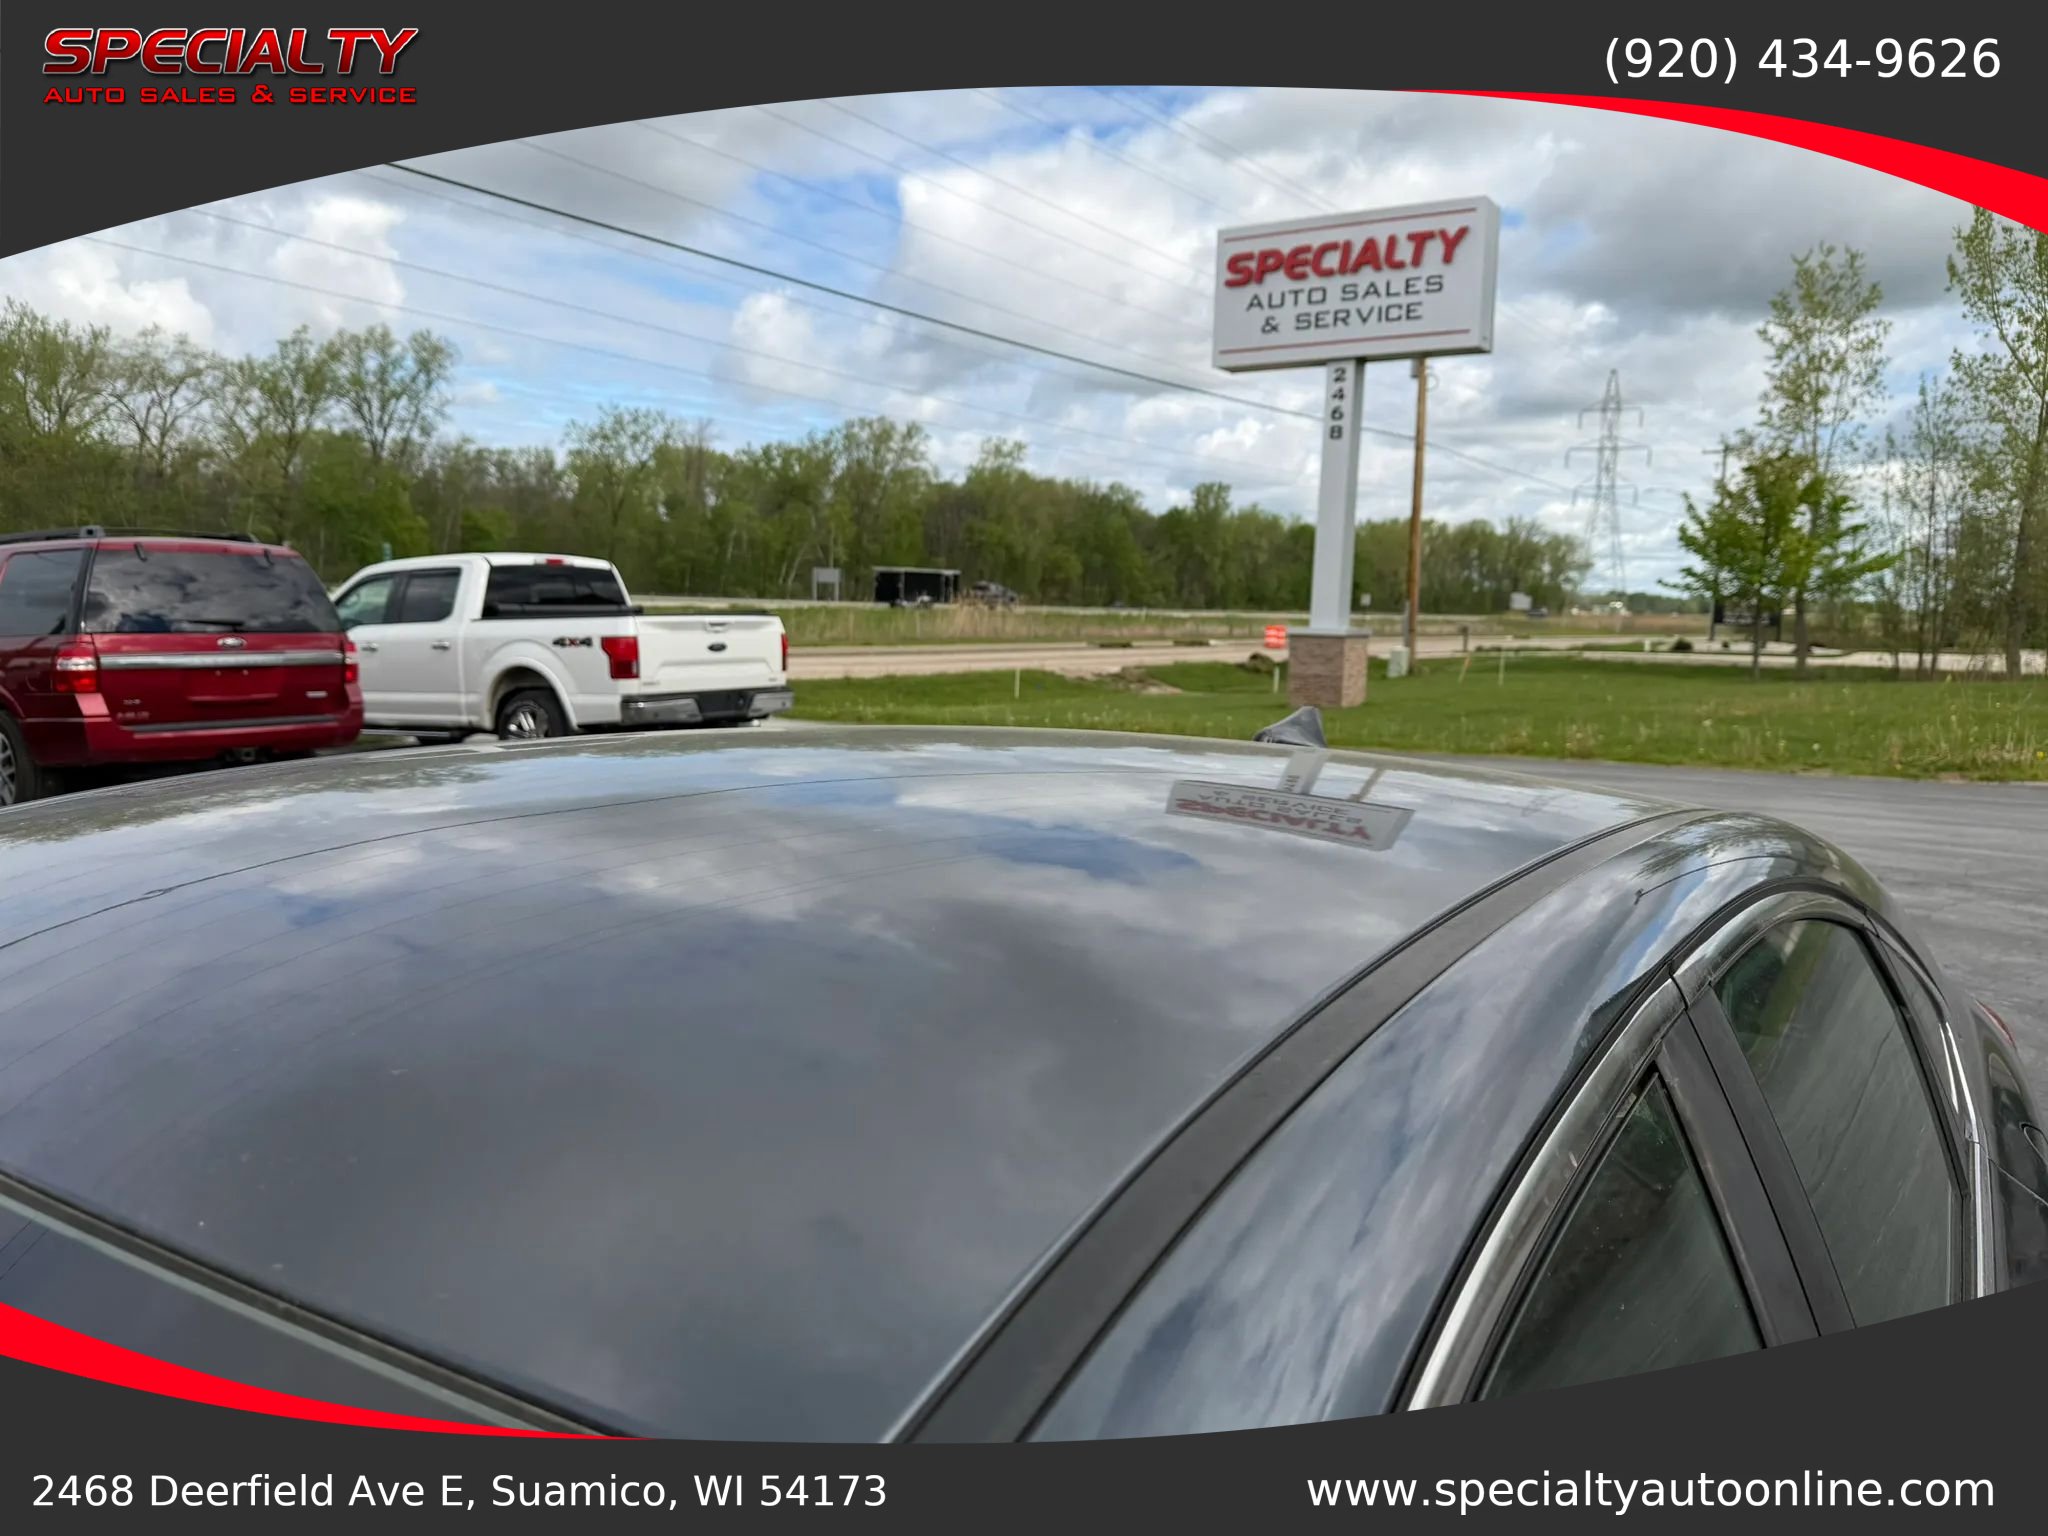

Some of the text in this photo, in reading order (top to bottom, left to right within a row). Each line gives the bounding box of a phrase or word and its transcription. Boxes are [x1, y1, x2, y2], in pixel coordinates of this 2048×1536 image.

[1224, 226, 1470, 288] SPECIALTY
[1246, 274, 1445, 312] AUTO SALES
[1260, 301, 1424, 335] & SERVICE
[1329, 366, 1347, 441] 2468
